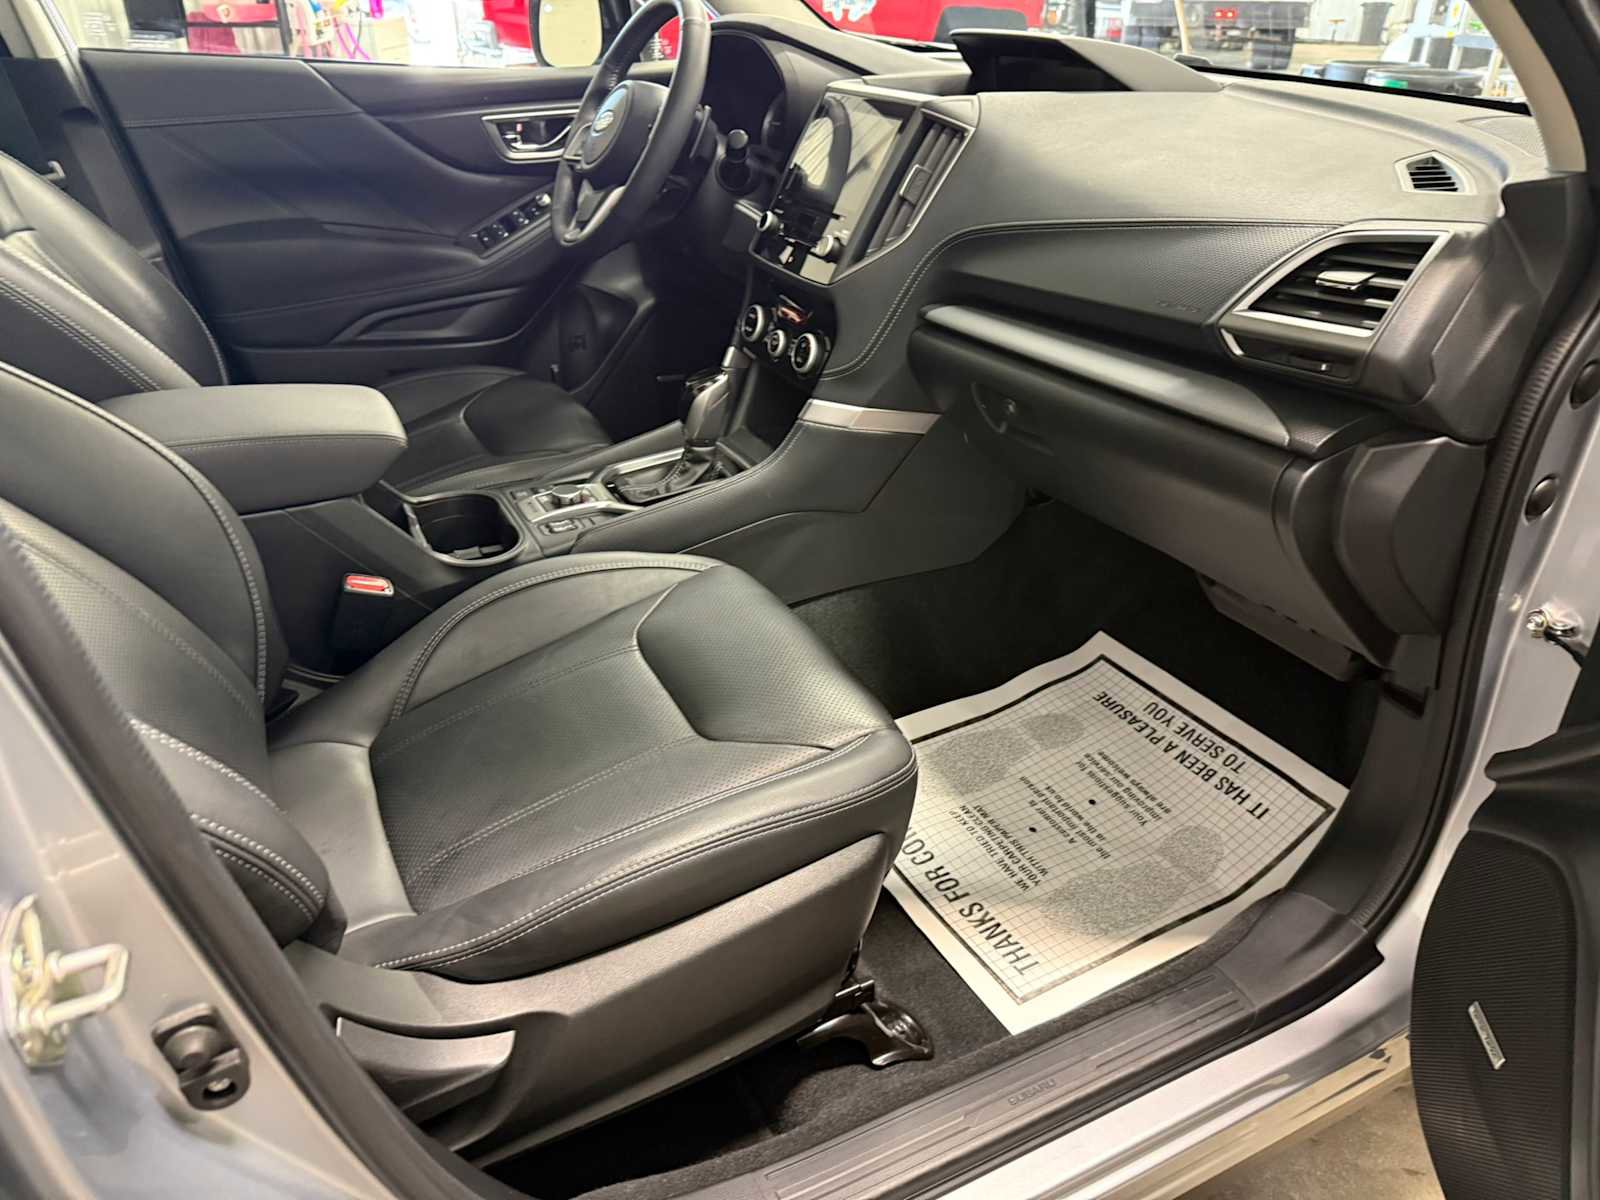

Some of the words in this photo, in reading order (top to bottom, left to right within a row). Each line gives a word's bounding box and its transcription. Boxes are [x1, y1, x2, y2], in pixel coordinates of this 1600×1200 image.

[1091, 690, 1168, 745] PLEASURE
[1142, 701, 1176, 729] YOU
[1162, 740, 1180, 754] A
[1172, 721, 1226, 760] SERVE
[1074, 760, 1088, 772] for
[1083, 752, 1112, 777] service
[1097, 750, 1131, 780] welcome
[1173, 750, 1218, 783] BEEN
[1222, 752, 1247, 775] TO
[1019, 775, 1046, 799] person
[1086, 770, 1131, 810] suggestions
[1109, 775, 1125, 789] our
[1129, 779, 1158, 803] always
[1213, 775, 1252, 806] HAS
[1054, 793, 1065, 804] to
[1122, 786, 1163, 822] improving
[1155, 800, 1173, 815] are
[972, 804, 990, 820] MAT
[1041, 797, 1079, 831] important
[1061, 801, 1084, 821] world
[1127, 808, 1149, 827] Your
[1245, 802, 1271, 821] IT
[966, 825, 979, 837] TO
[1035, 807, 1071, 839] customer
[1083, 820, 1098, 834] the
[976, 835, 999, 858] TRIED
[1010, 838, 1030, 857] THIS
[1068, 837, 1078, 845] A
[1075, 829, 1098, 848] most
[1096, 847, 1112, 860] the
[995, 858, 1018, 879] HAVE
[1018, 863, 1041, 887] YOUR
[1026, 854, 1049, 877] WITH
[924, 865, 971, 903] FOR
[1014, 877, 1030, 892] WE
[958, 902, 1039, 976] THANKS
